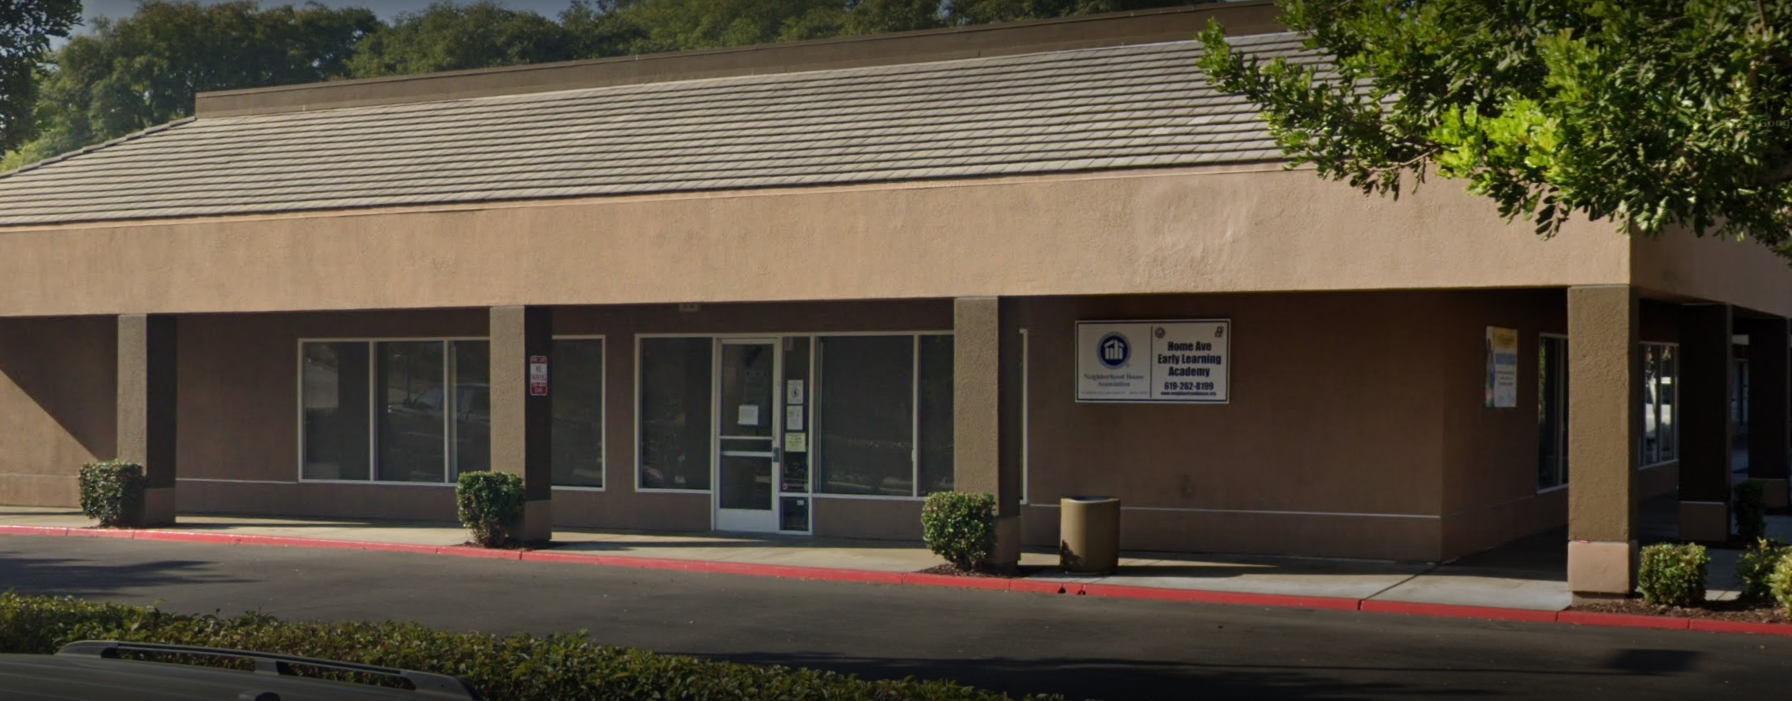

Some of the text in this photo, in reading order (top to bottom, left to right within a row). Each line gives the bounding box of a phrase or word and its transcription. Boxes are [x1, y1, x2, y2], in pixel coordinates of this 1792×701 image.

[1167, 341, 1212, 352] Home Ave
[1157, 354, 1222, 366] Early Learning
[1168, 366, 1211, 378] Academy
[1164, 381, 1214, 391] 619-262-8199
